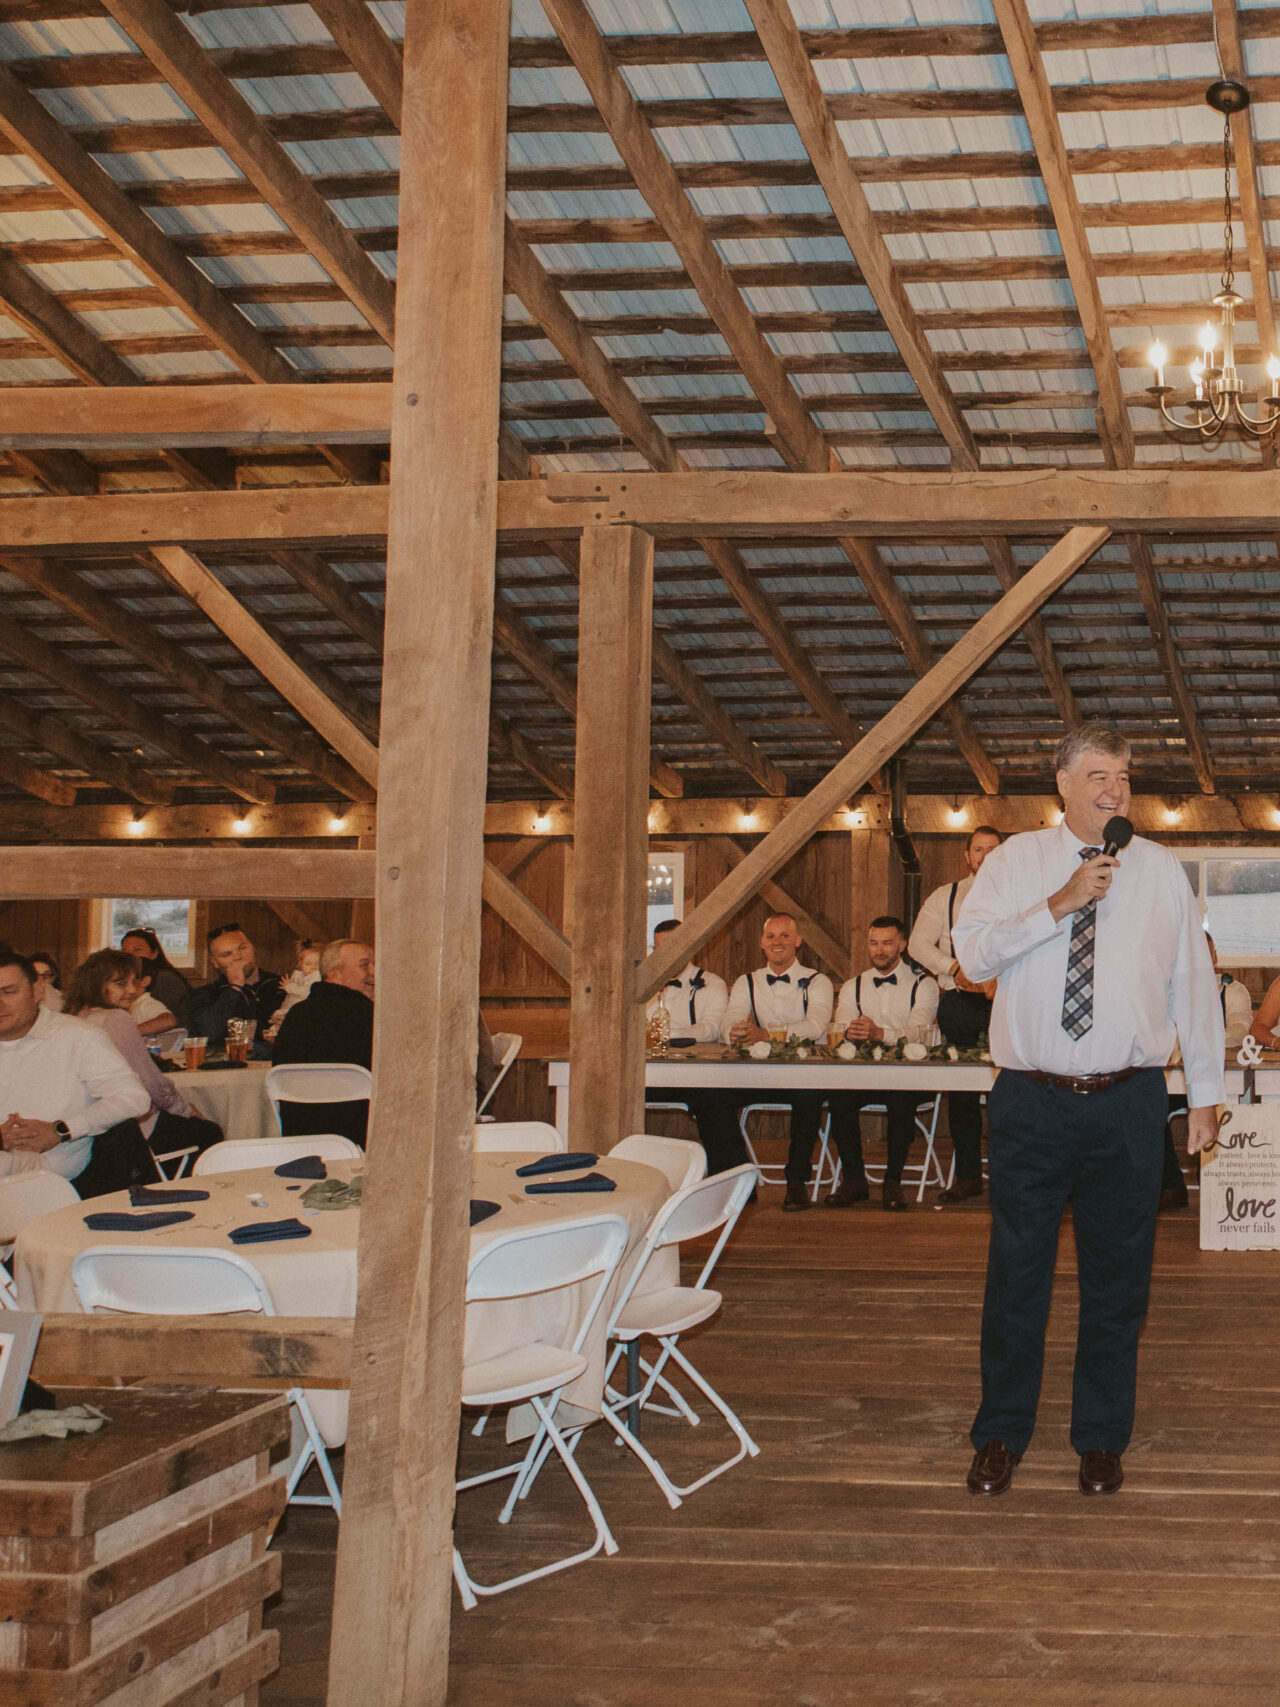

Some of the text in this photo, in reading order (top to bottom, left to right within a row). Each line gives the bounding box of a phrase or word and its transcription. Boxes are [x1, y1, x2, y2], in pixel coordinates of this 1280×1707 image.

[1236, 1034, 1264, 1066] &
[1203, 1110, 1272, 1153] Love
[1203, 1170, 1225, 1178] always
[1248, 1170, 1270, 1178] always
[1226, 1161, 1248, 1169] always
[1217, 1187, 1276, 1224] love
[1220, 1222, 1276, 1232] never fails
